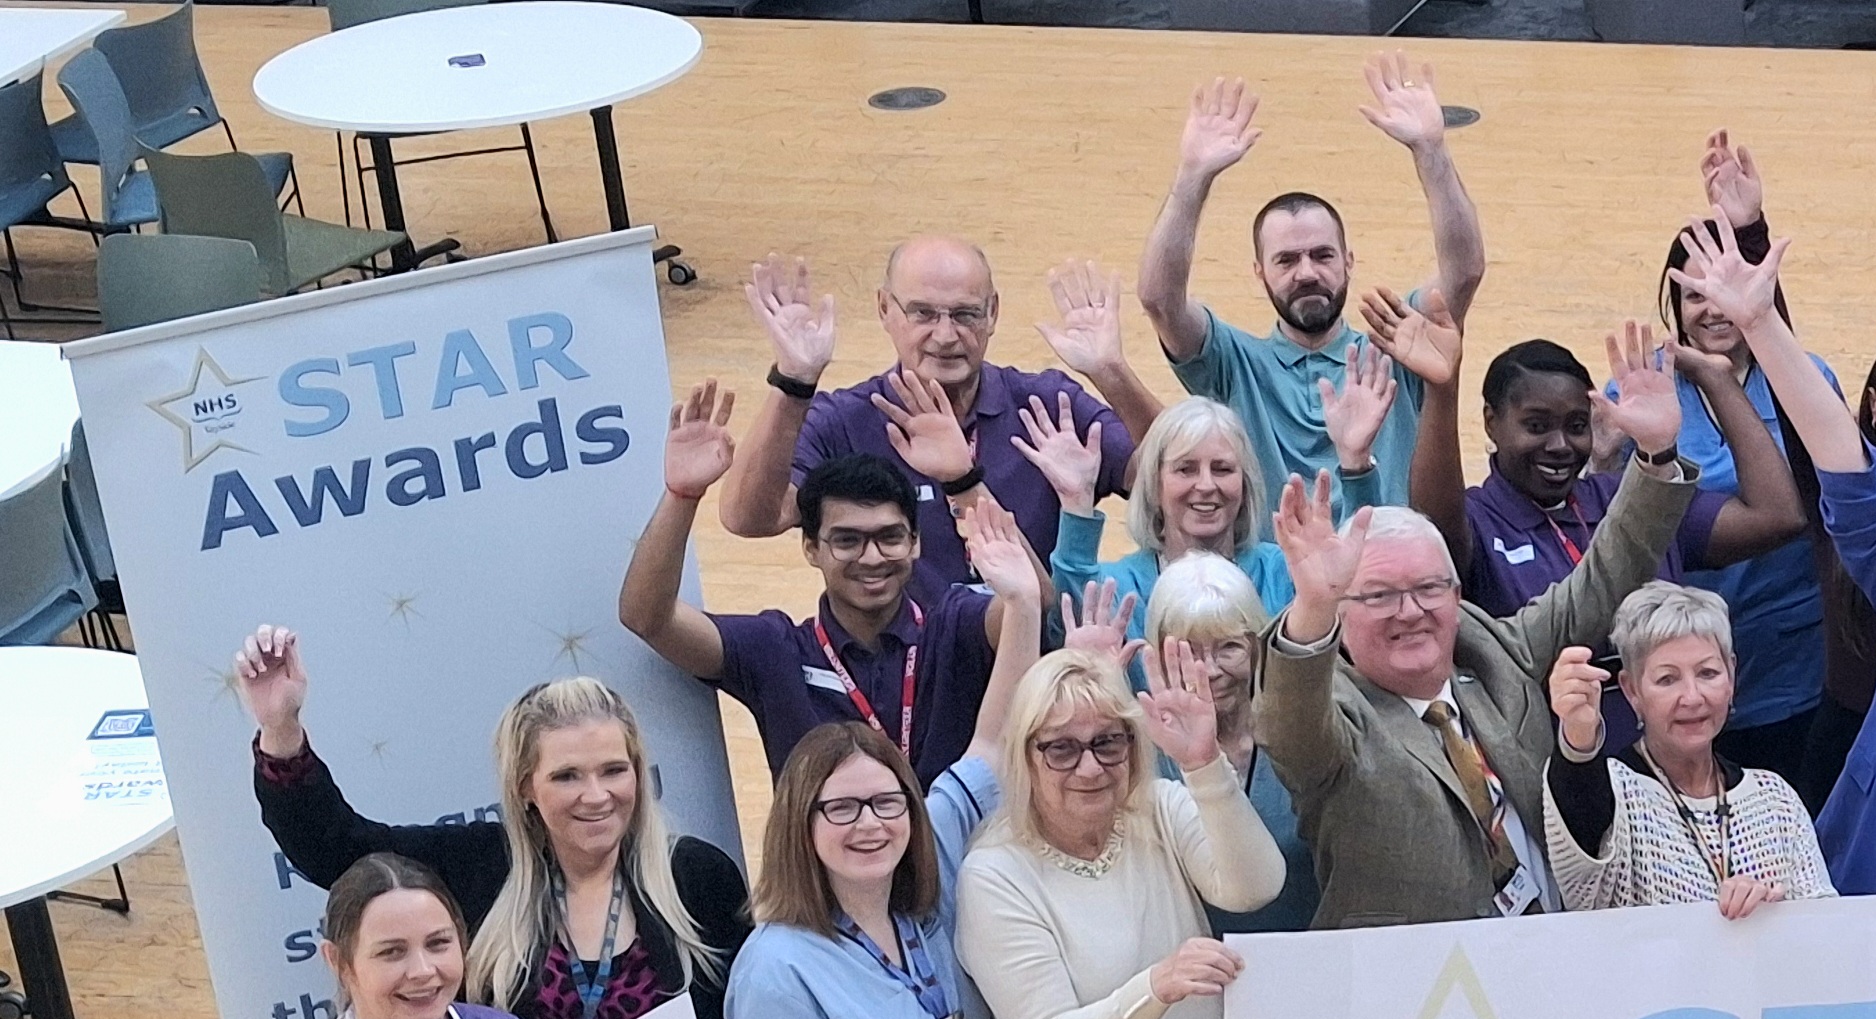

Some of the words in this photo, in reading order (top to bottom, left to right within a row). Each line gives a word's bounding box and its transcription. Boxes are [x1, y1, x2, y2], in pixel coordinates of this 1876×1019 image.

[193, 393, 237, 416] NHS
[276, 310, 592, 439] STAR
[201, 396, 630, 551] Awards
